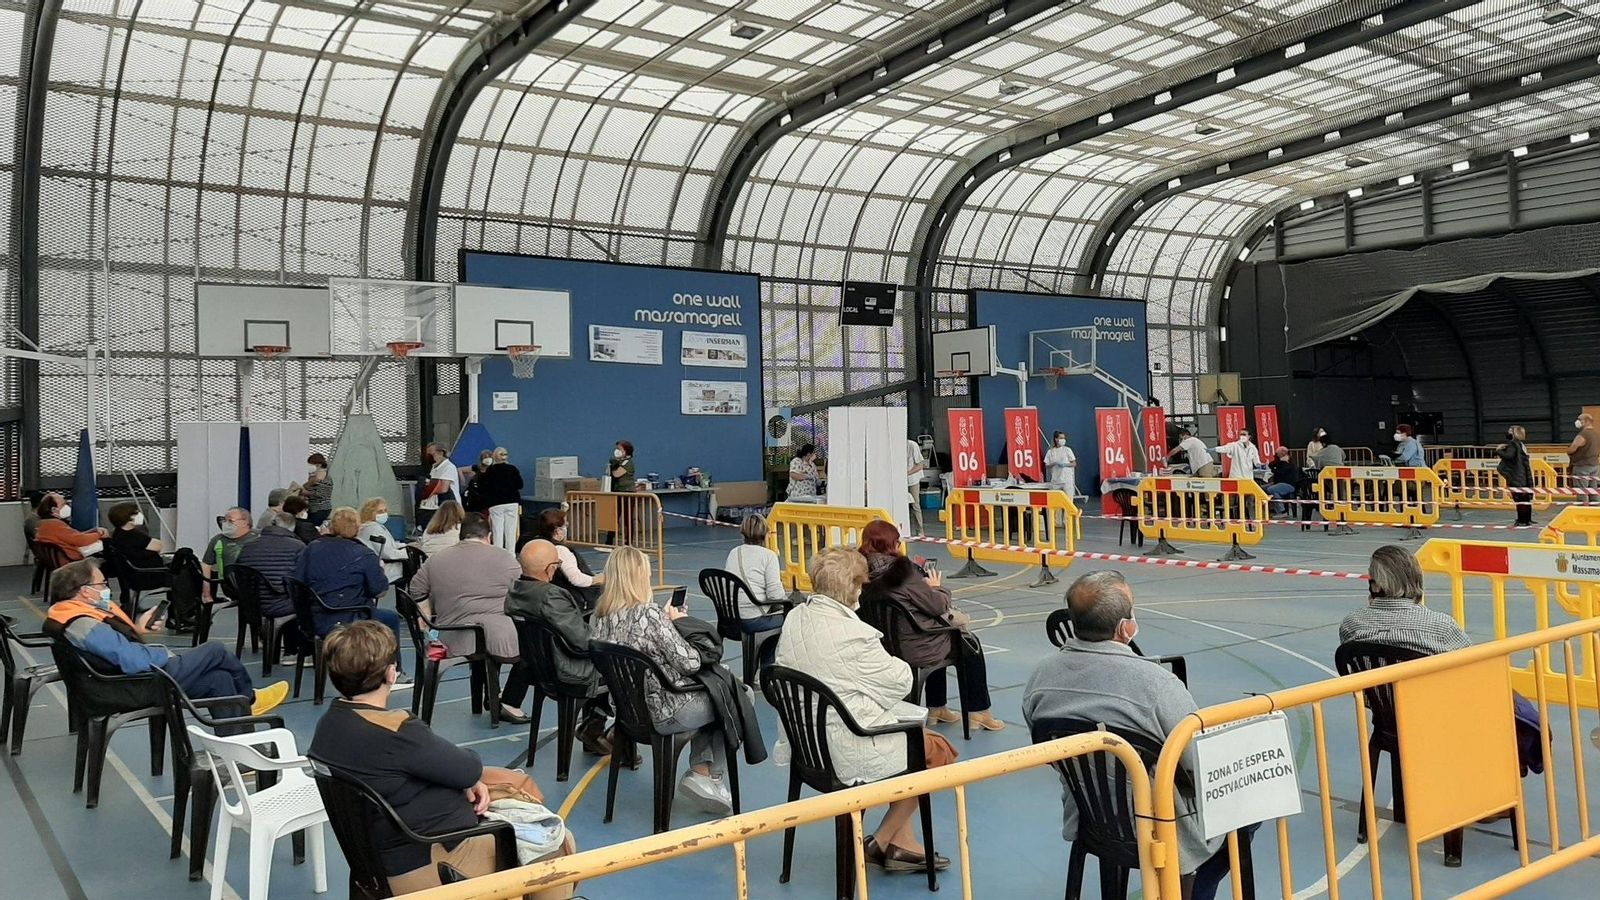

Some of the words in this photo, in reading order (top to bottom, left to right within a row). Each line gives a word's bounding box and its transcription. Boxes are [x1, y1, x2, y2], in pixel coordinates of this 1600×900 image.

[673, 293, 702, 306] one
[707, 295, 741, 308] wall
[634, 309, 742, 327] massamagrell
[1094, 316, 1111, 326] one
[1114, 317, 1135, 328] wall
[706, 337, 741, 345] INSERMAN
[1105, 447, 1125, 464] 04
[1149, 445, 1162, 462] 03
[1263, 441, 1275, 456] 01
[958, 452, 978, 471] 06
[1014, 449, 1033, 468] 05
[1207, 764, 1232, 783] ZONA
[1233, 759, 1244, 773] DE
[1245, 747, 1285, 767] ESPERA
[1206, 763, 1293, 802] POSTVACUNACIÓN
